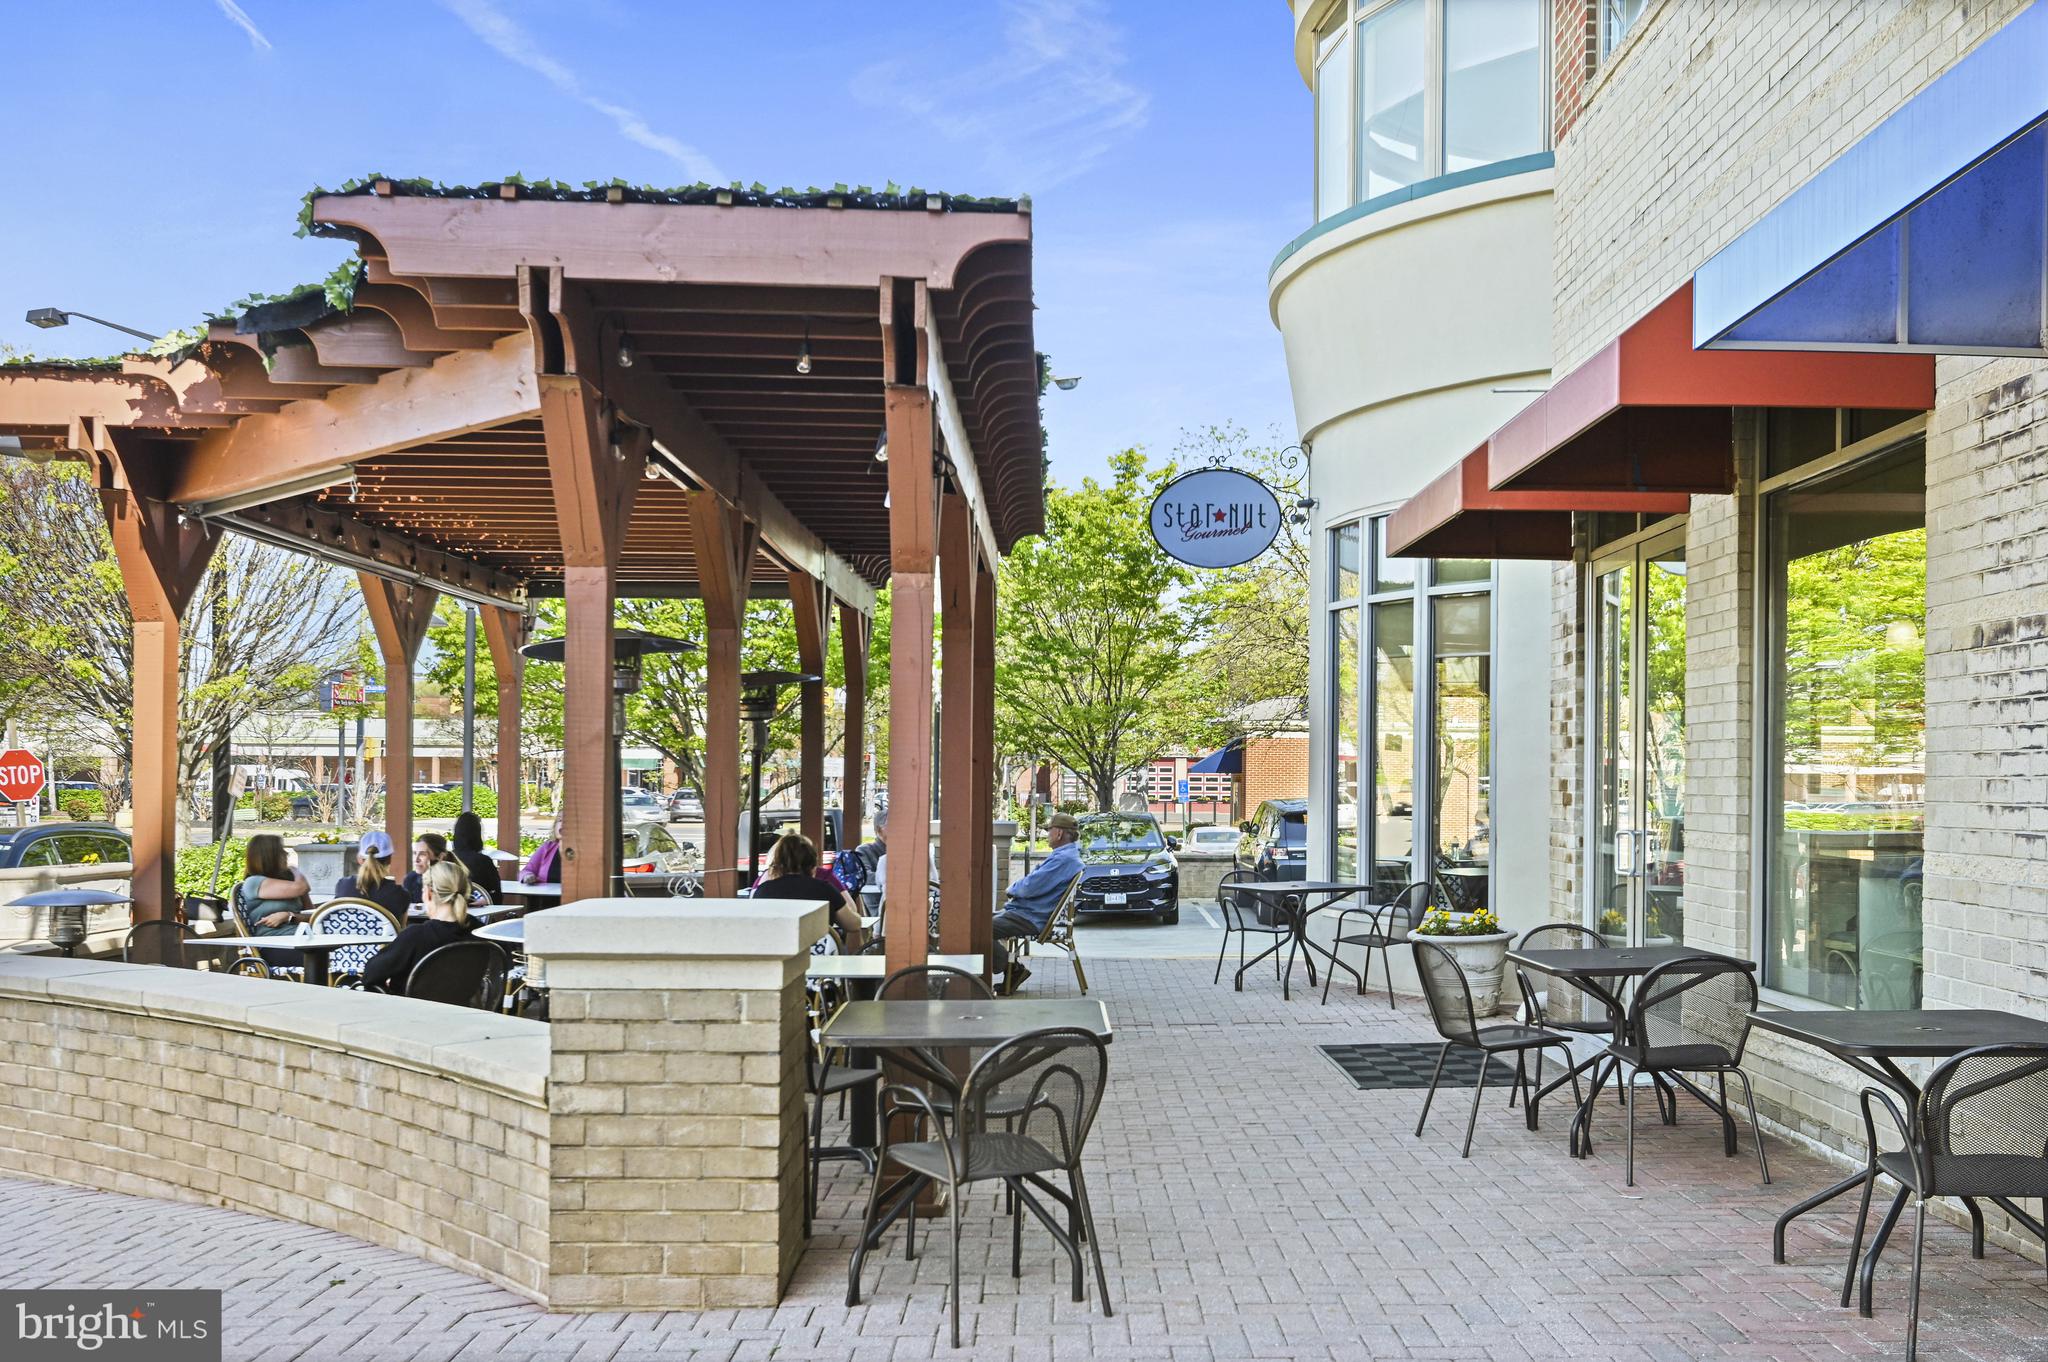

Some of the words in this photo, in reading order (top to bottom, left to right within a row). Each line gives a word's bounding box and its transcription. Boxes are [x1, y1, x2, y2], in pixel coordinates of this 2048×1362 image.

[1163, 502, 1215, 529] Star
[1180, 520, 1251, 543] Gourmet
[0, 764, 41, 786] STOP
